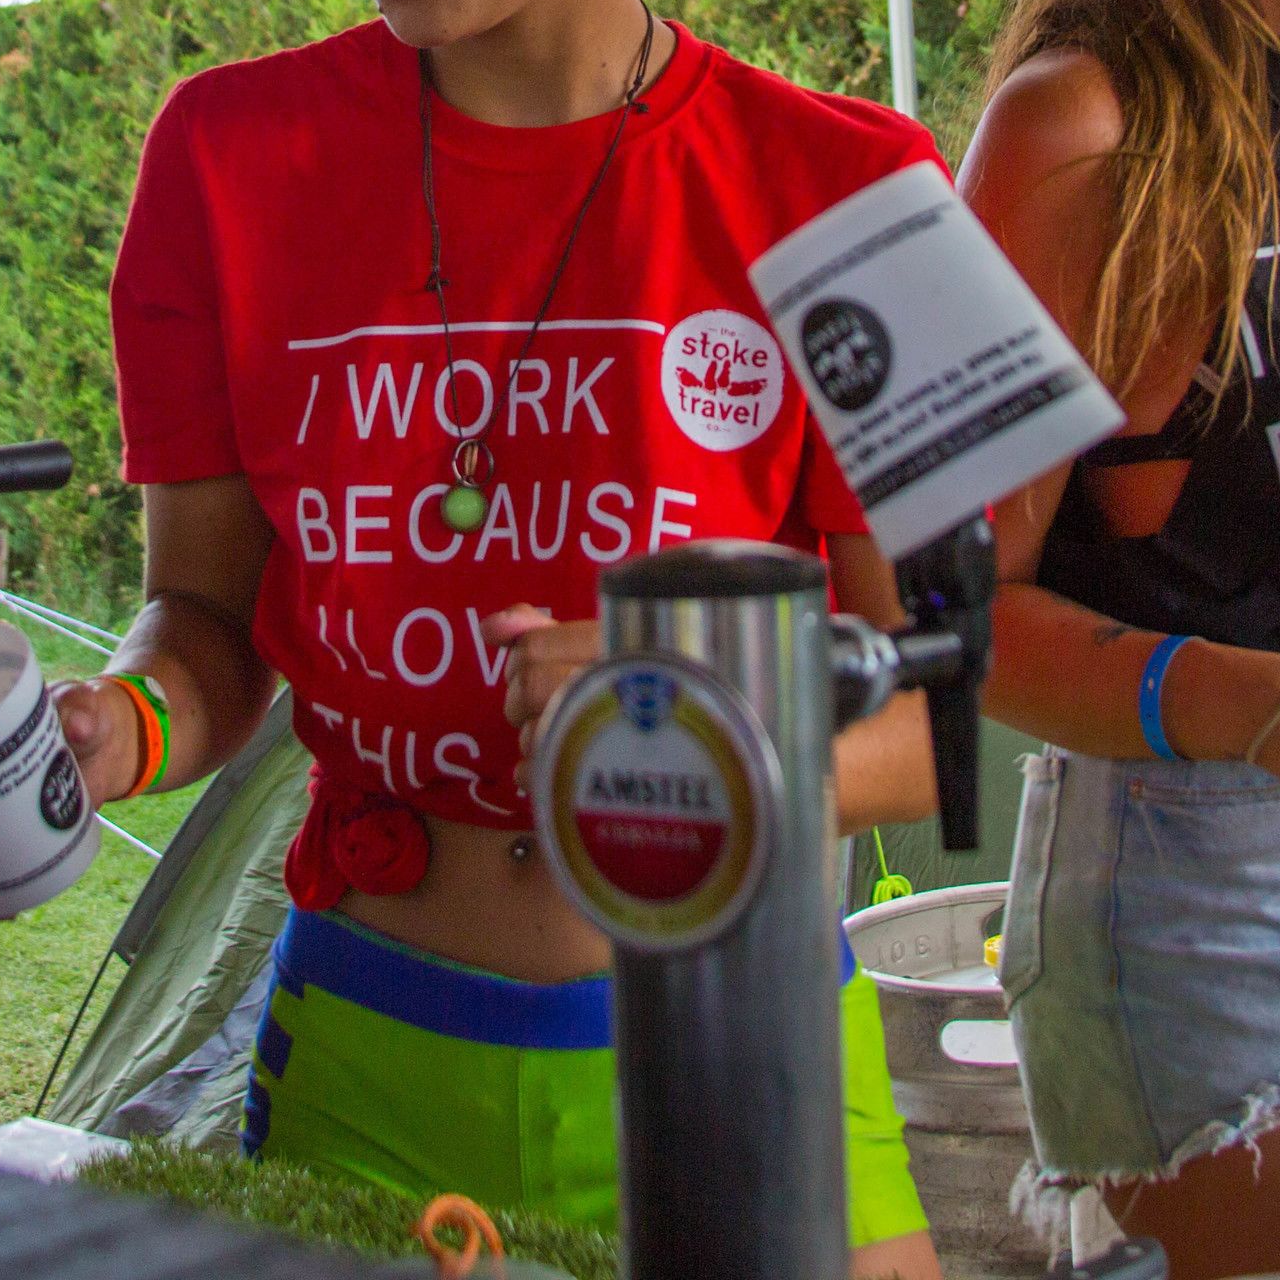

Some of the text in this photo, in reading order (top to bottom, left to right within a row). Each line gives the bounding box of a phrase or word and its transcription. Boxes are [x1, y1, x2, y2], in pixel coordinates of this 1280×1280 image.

[682, 332, 768, 368] stoke
[296, 357, 616, 444] I WORK
[678, 385, 760, 427] travel
[346, 606, 554, 687] LOV
[588, 769, 712, 811] AMSTEL
